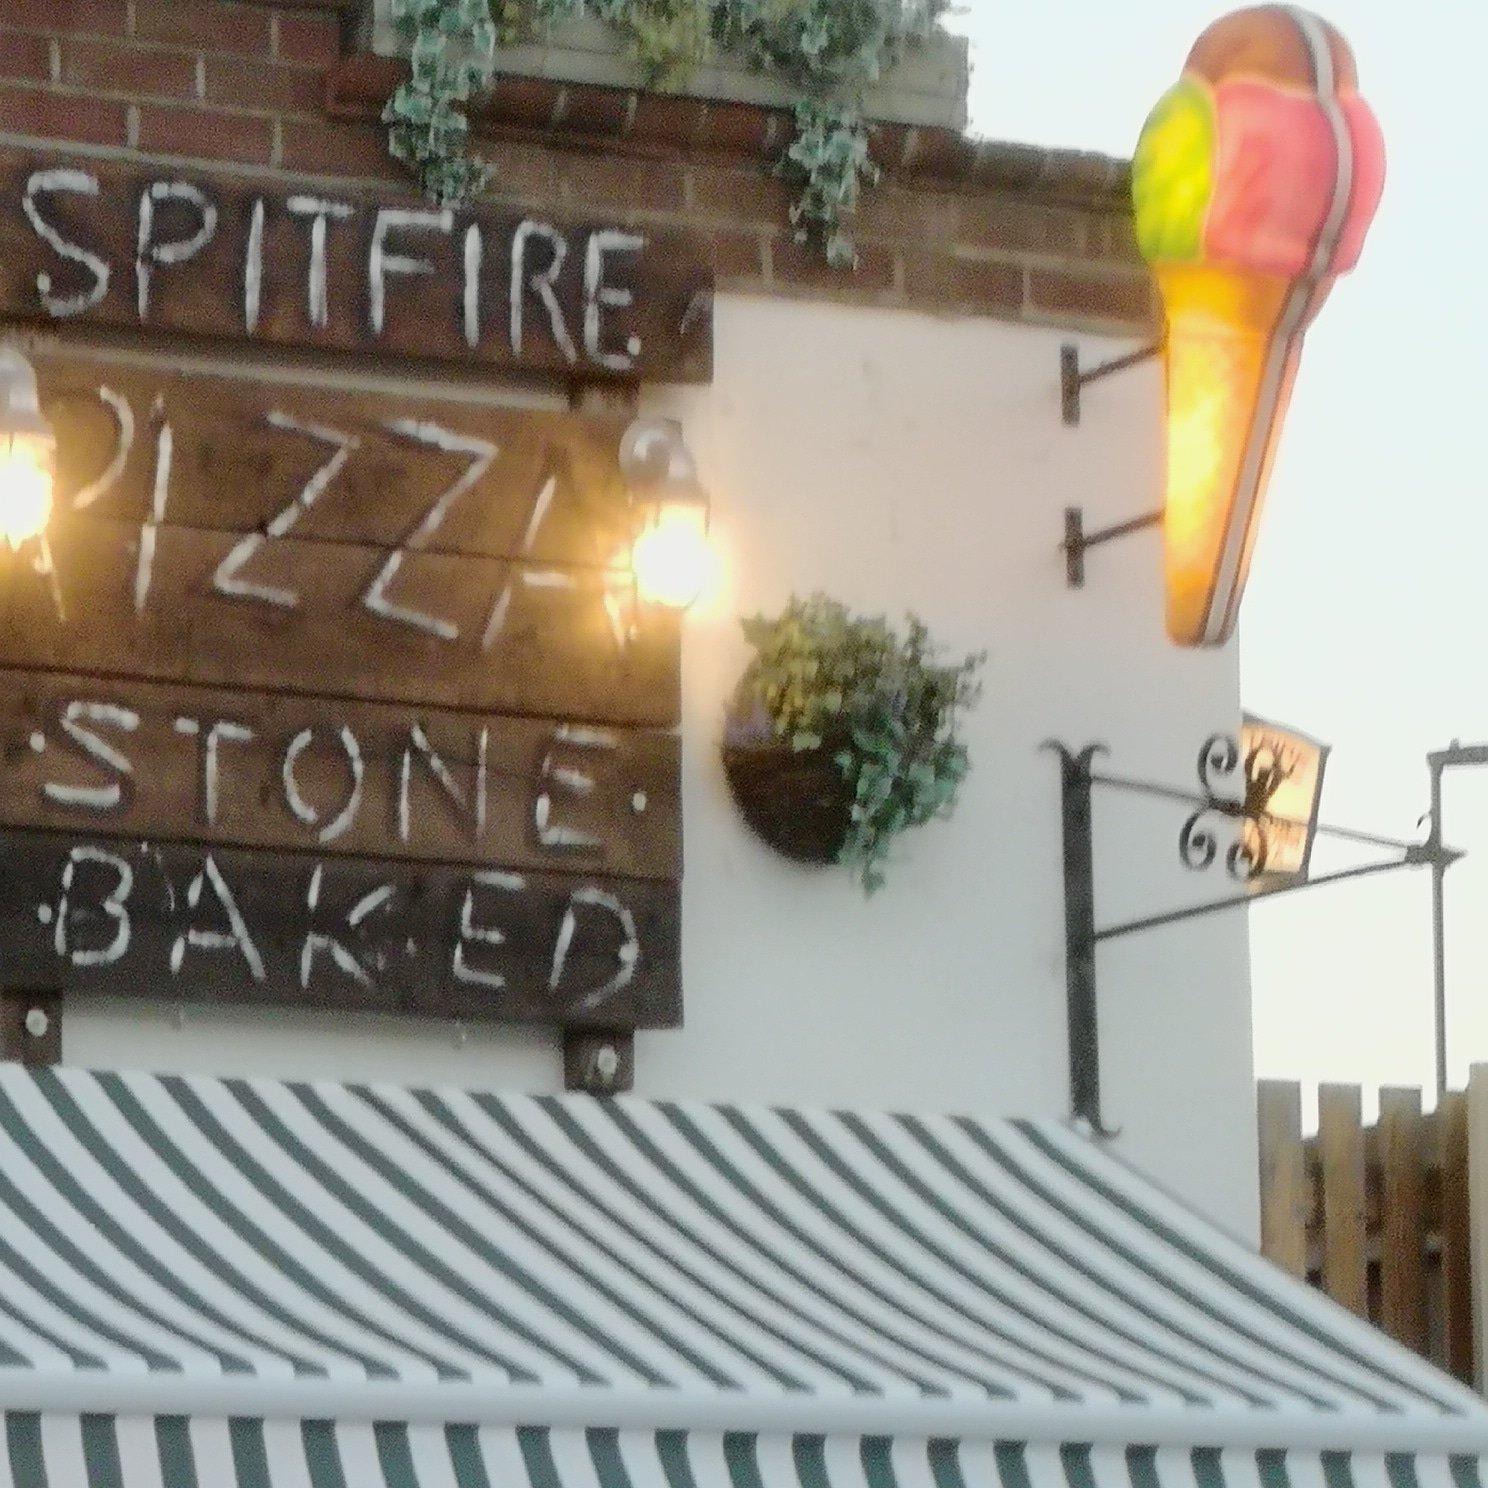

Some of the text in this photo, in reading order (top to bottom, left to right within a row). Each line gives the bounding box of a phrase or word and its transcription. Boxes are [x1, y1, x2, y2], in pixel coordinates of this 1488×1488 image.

[22, 169, 646, 370] SPITFIRE
[42, 701, 619, 847] STONE
[54, 845, 639, 1011] BAKED
